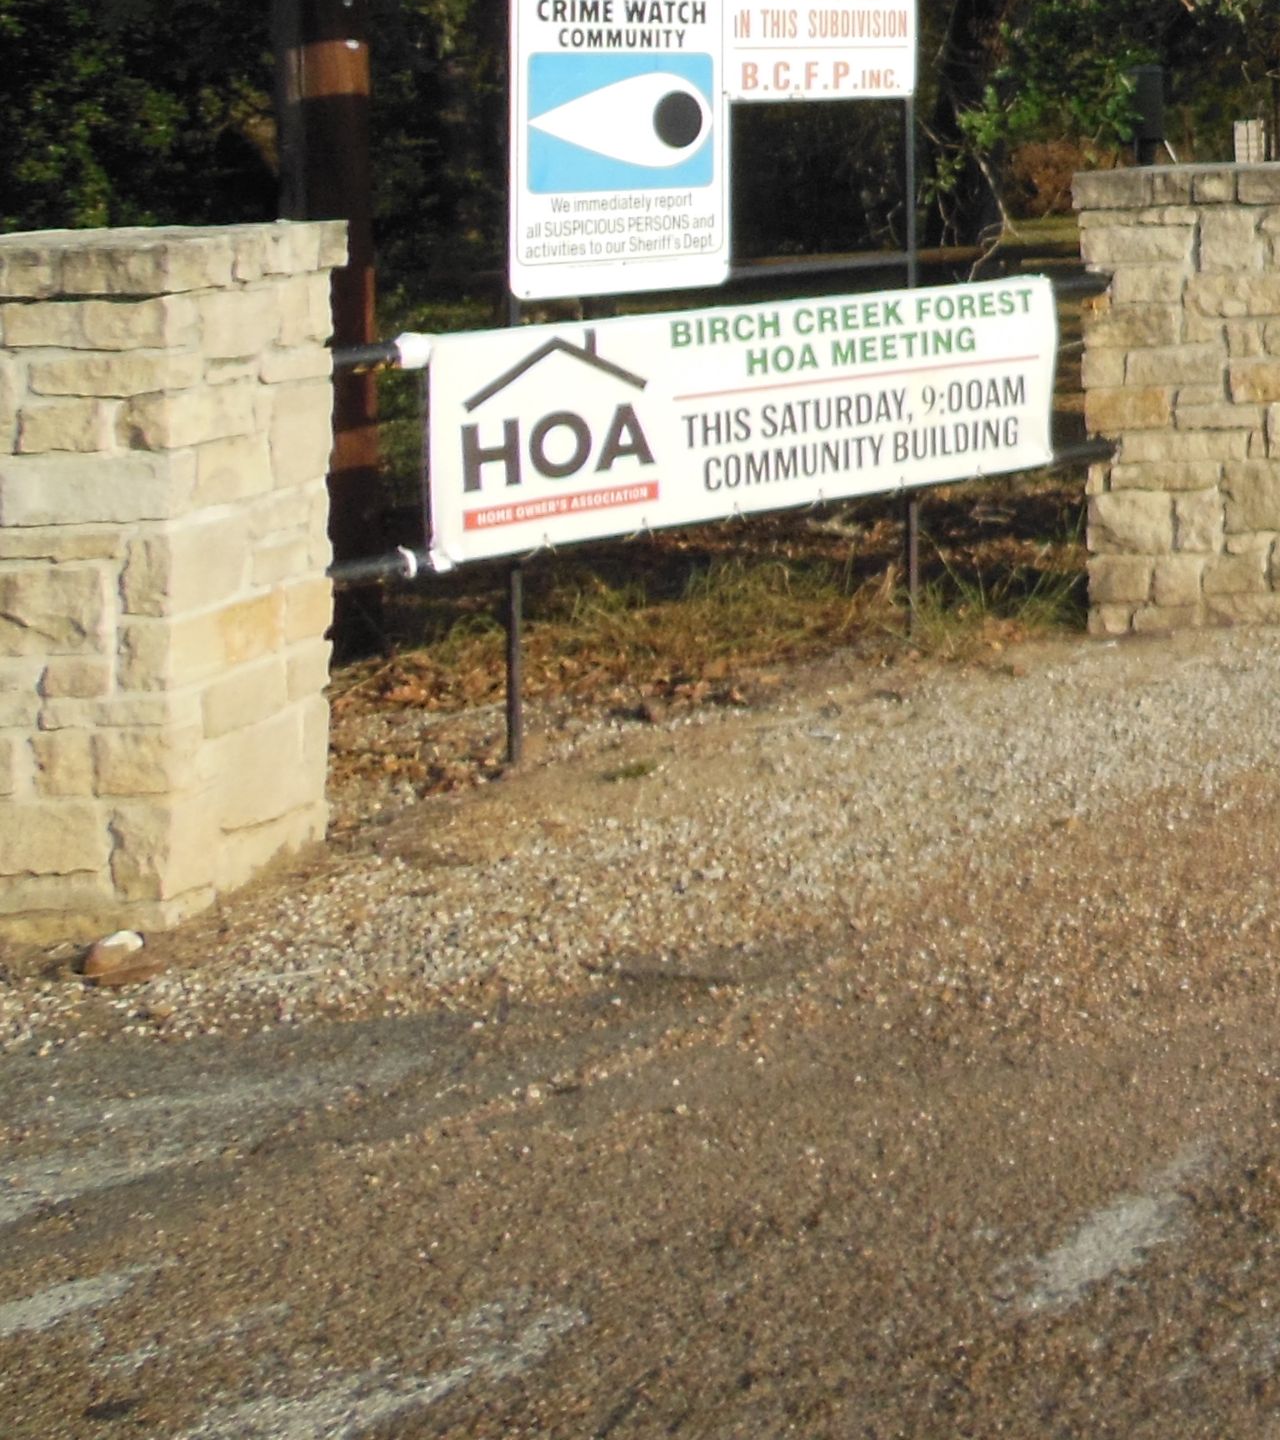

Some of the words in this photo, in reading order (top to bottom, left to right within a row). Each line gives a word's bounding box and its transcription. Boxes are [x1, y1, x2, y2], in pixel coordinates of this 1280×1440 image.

[624, 0, 706, 24] WATCH
[734, 9, 750, 38] IN
[760, 9, 797, 38] THIS
[808, 9, 907, 38] SUBDIVISION
[558, 28, 686, 48] COMMUNITY
[551, 197, 570, 213] We
[573, 194, 651, 213] immediately
[654, 193, 693, 211] report
[526, 222, 541, 239] all
[544, 217, 625, 237] SUSPICIOUS
[628, 214, 690, 232] PERSONS
[692, 213, 715, 229] and
[525, 242, 586, 259] activities
[590, 241, 602, 255] to
[606, 241, 625, 255] our
[670, 312, 780, 348] BIRCH
[793, 299, 902, 335] CREEK
[915, 289, 1034, 323] FOREST
[746, 345, 819, 376] HOA
[831, 327, 976, 367] MEETING
[682, 406, 751, 449] THIS
[761, 387, 914, 439] SATURDAY,
[921, 374, 1026, 418] 9:00AM
[461, 402, 656, 492] HOA
[703, 434, 885, 491] COMMUNITY
[893, 416, 1019, 463] BUILDING
[477, 507, 513, 525] HOME
[516, 499, 568, 518] OWNER'S
[571, 486, 649, 508] ASSOCIATION
